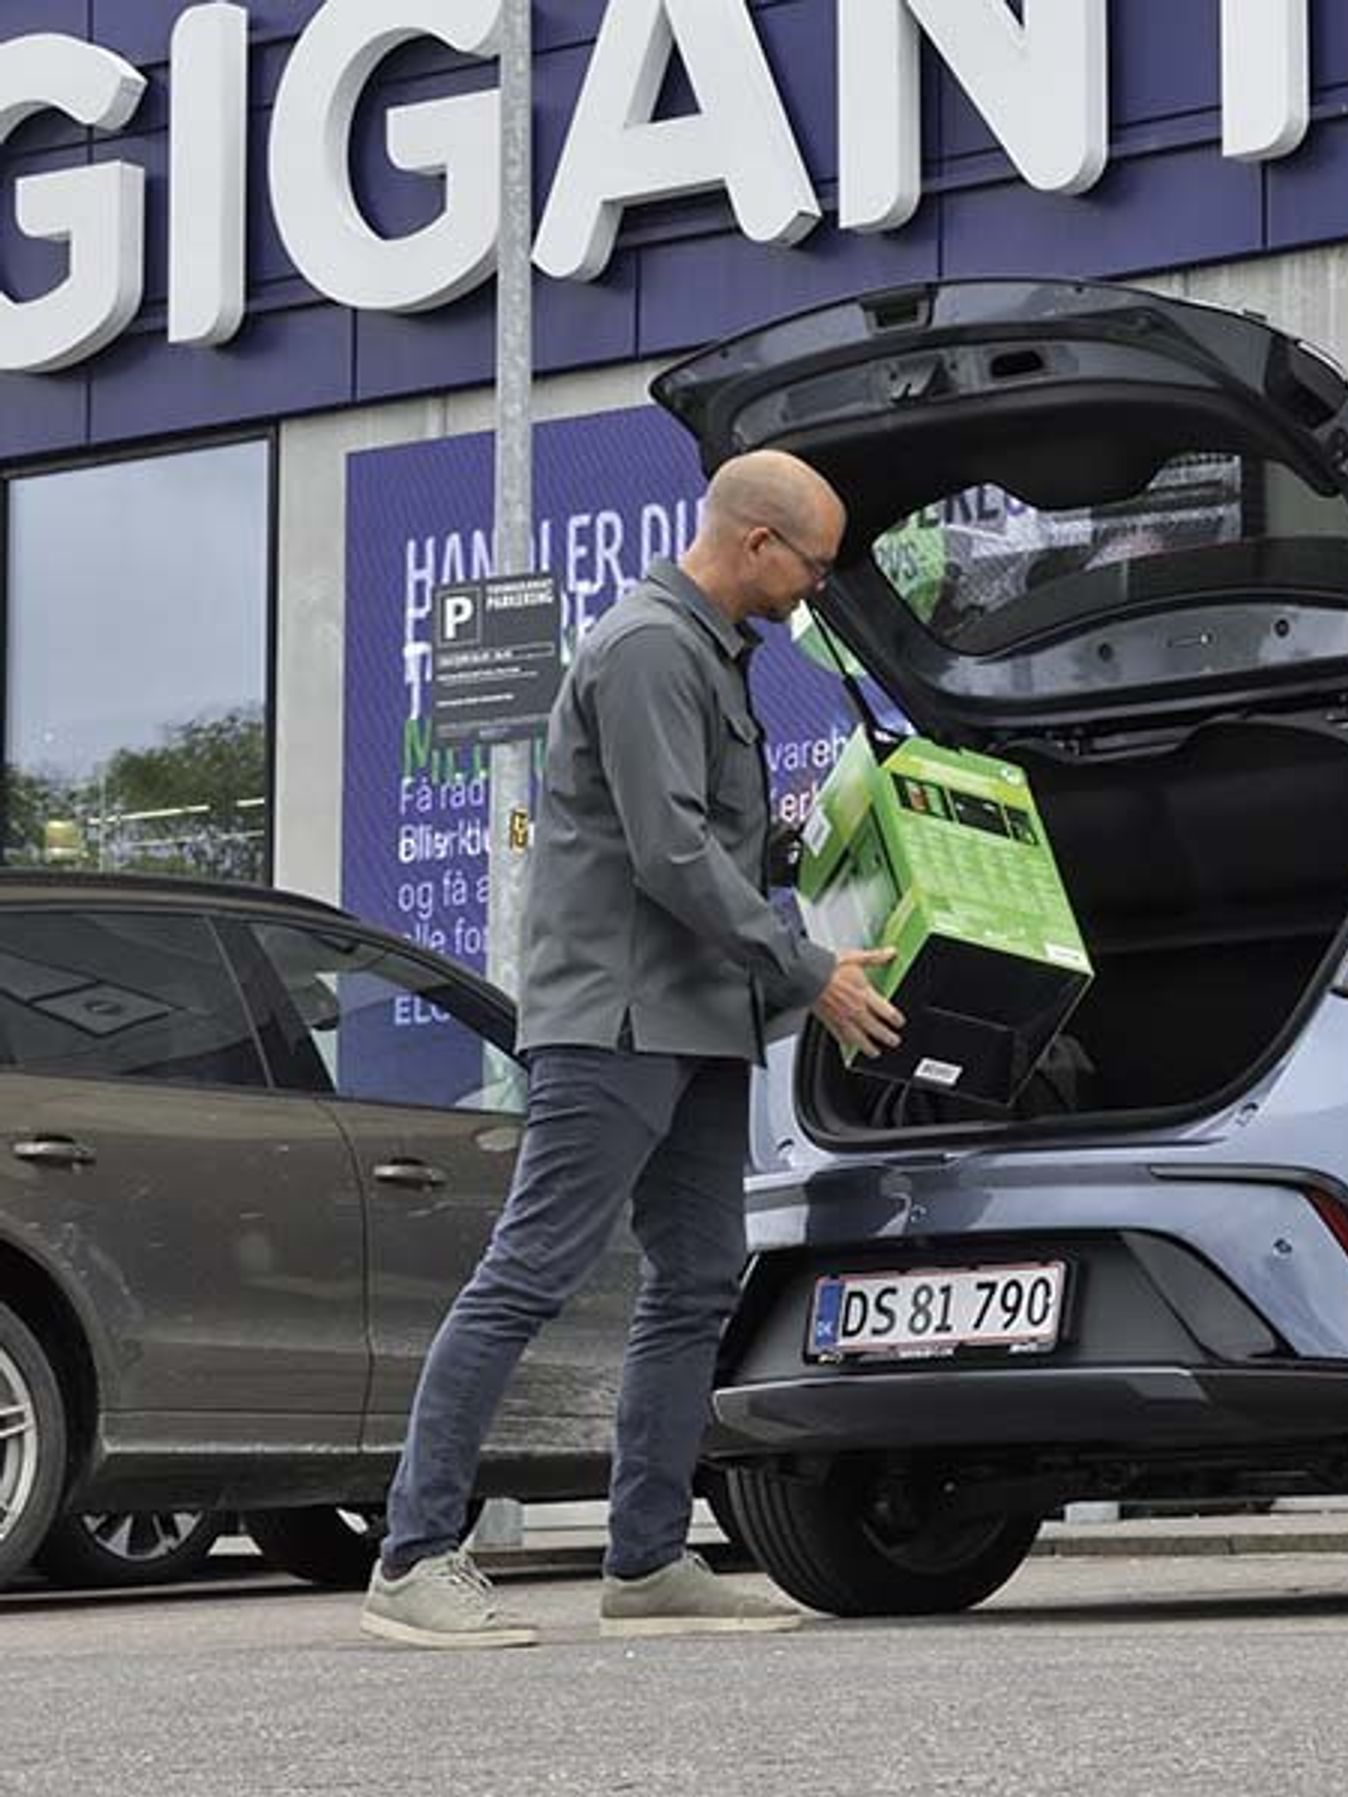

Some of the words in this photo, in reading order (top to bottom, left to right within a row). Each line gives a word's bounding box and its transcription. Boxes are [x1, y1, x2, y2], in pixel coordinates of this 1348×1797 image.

[406, 511, 628, 617] HANLER
[443, 596, 473, 640] P
[398, 881, 433, 919] og
[443, 869, 468, 906] få
[841, 1287, 898, 1338] DS
[908, 1284, 954, 1335] 81
[973, 1277, 1052, 1331] 790
